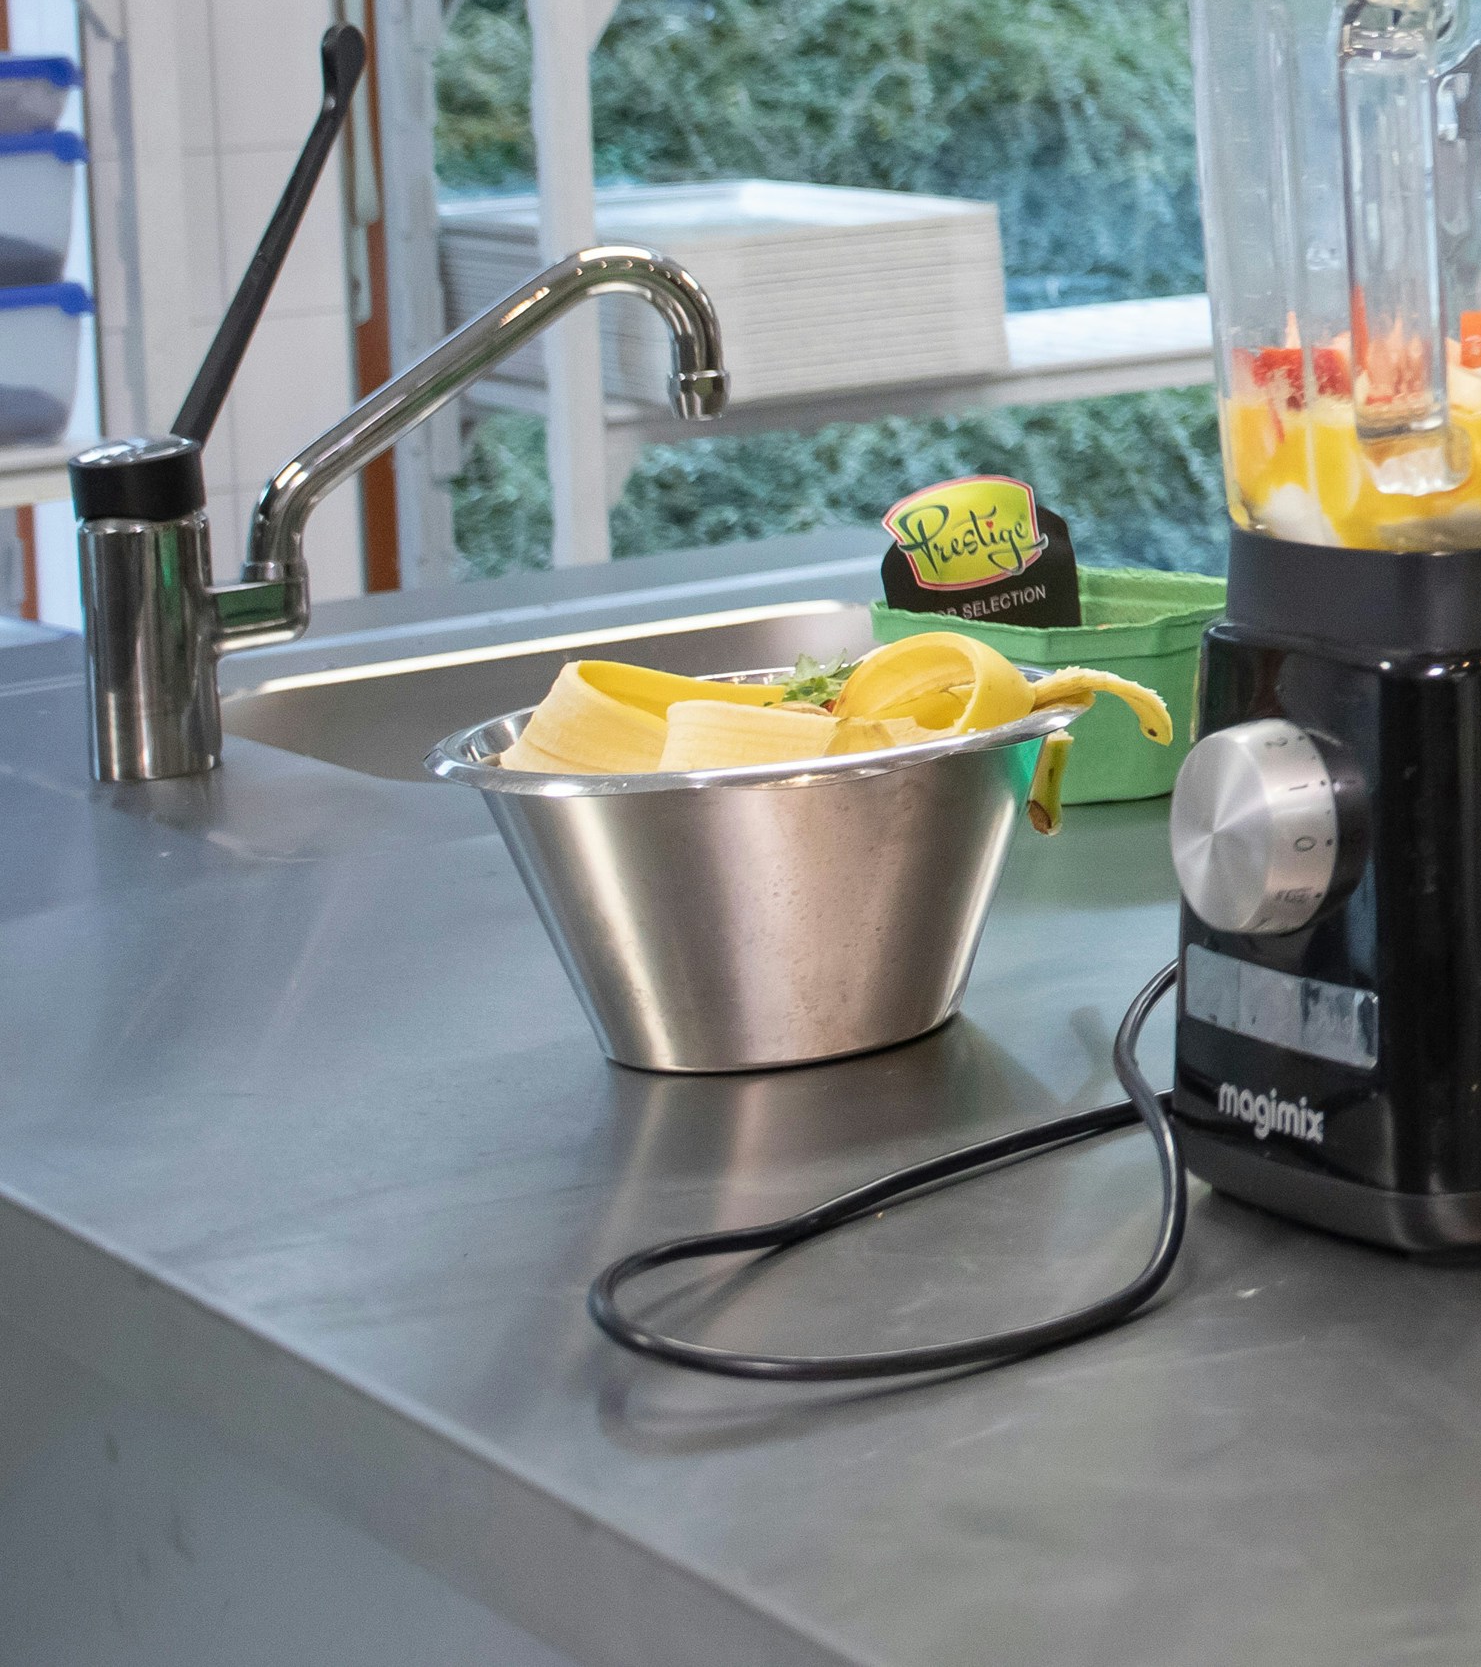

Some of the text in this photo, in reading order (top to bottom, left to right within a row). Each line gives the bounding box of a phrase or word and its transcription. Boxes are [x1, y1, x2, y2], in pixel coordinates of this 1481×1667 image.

[898, 504, 1049, 574] Prestige
[962, 584, 1047, 619] SELECTION
[1218, 1082, 1325, 1144] magimix
